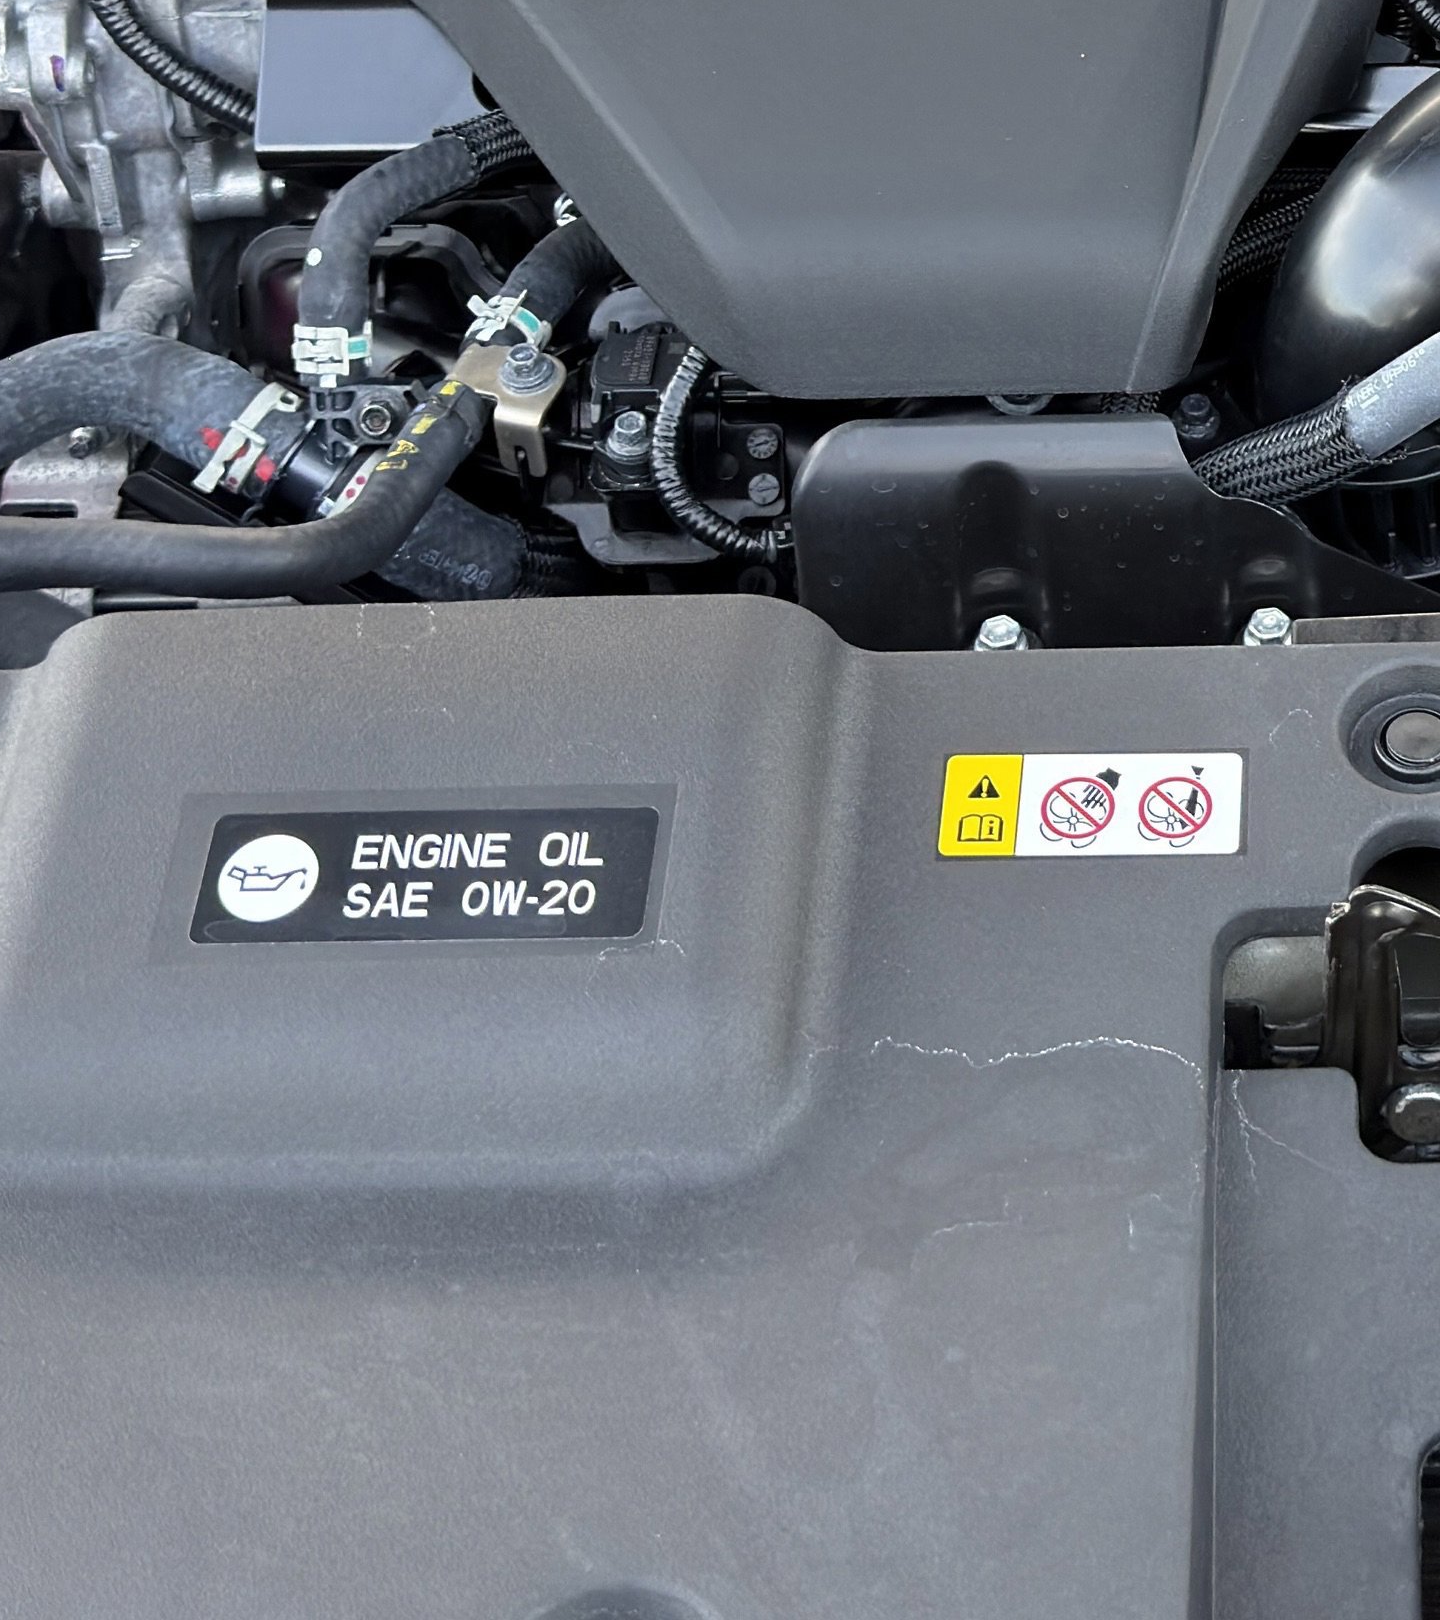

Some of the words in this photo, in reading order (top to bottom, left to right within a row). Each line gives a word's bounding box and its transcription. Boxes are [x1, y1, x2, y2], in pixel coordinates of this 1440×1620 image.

[350, 832, 511, 870] ENGINE
[538, 831, 604, 868] OIL
[341, 881, 434, 919] SAE
[461, 880, 596, 917] 0W-20
